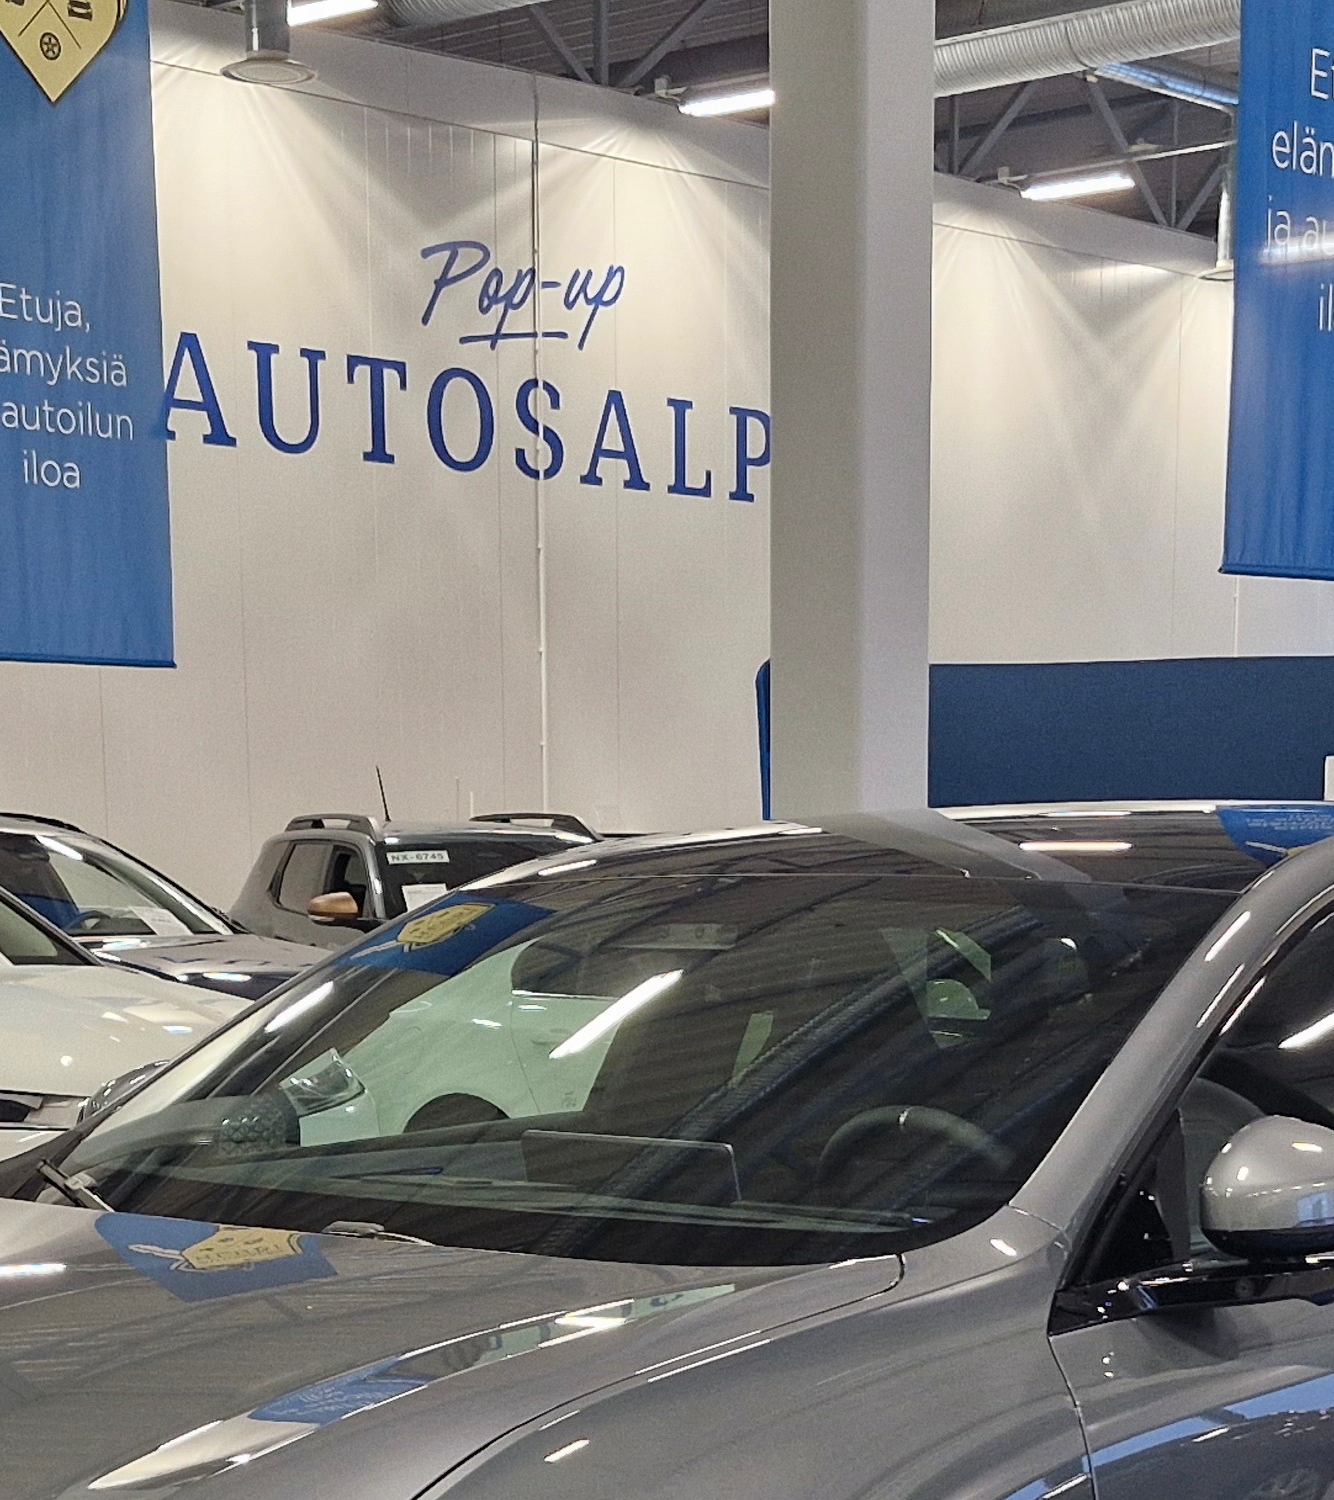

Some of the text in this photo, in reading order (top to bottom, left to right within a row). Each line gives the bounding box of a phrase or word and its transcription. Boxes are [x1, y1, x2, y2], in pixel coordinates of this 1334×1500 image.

[1264, 194, 1291, 255] ja
[421, 240, 626, 350] Pop-up
[1, 399, 134, 441] autoilun
[22, 449, 81, 489] iloa
